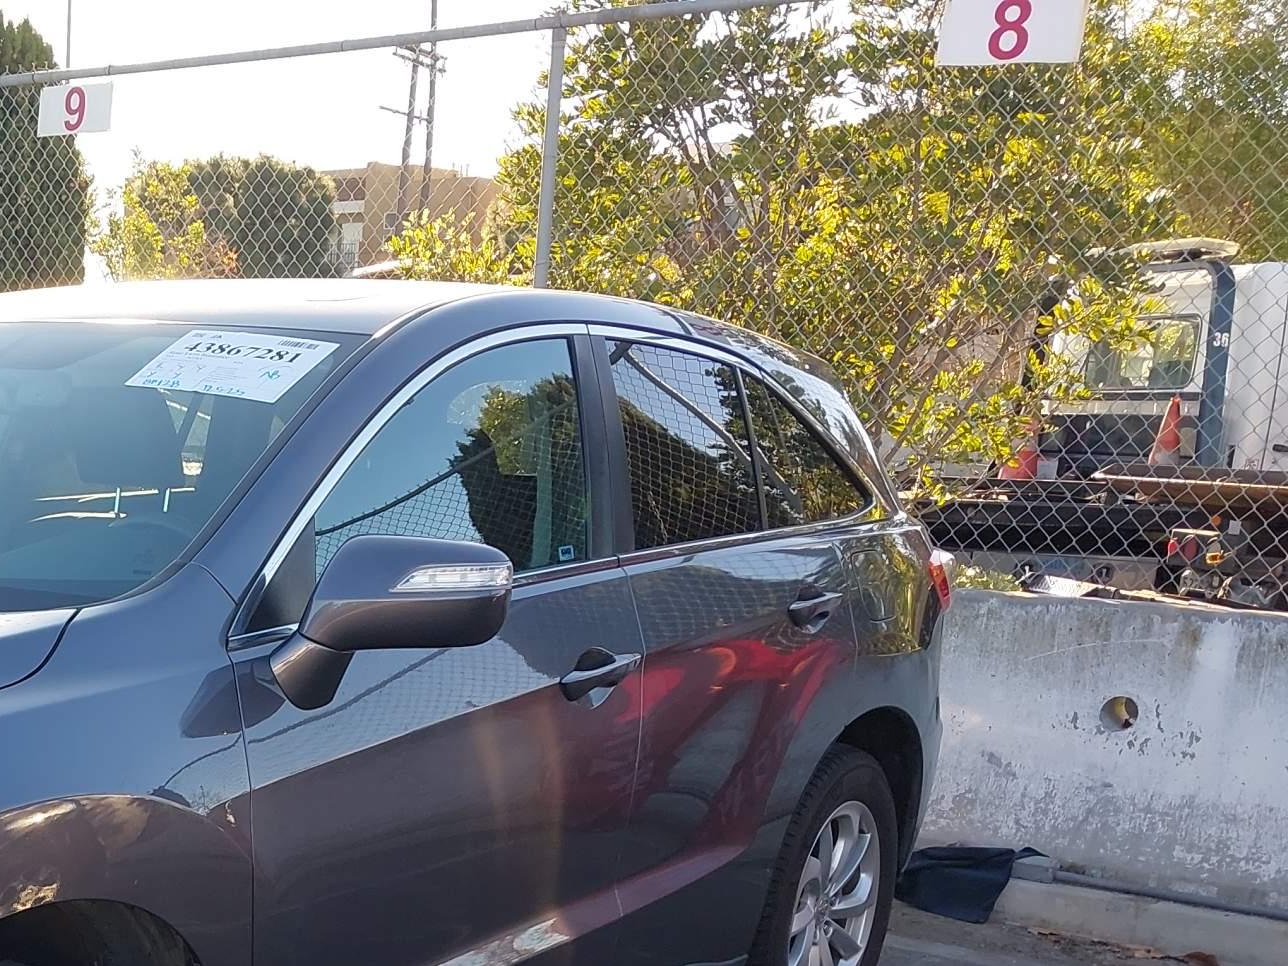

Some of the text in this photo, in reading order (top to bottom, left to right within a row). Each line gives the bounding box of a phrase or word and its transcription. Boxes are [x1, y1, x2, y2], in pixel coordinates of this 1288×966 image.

[988, 0, 1032, 60] 8
[63, 86, 86, 131] 9
[184, 341, 303, 363] 43867281
